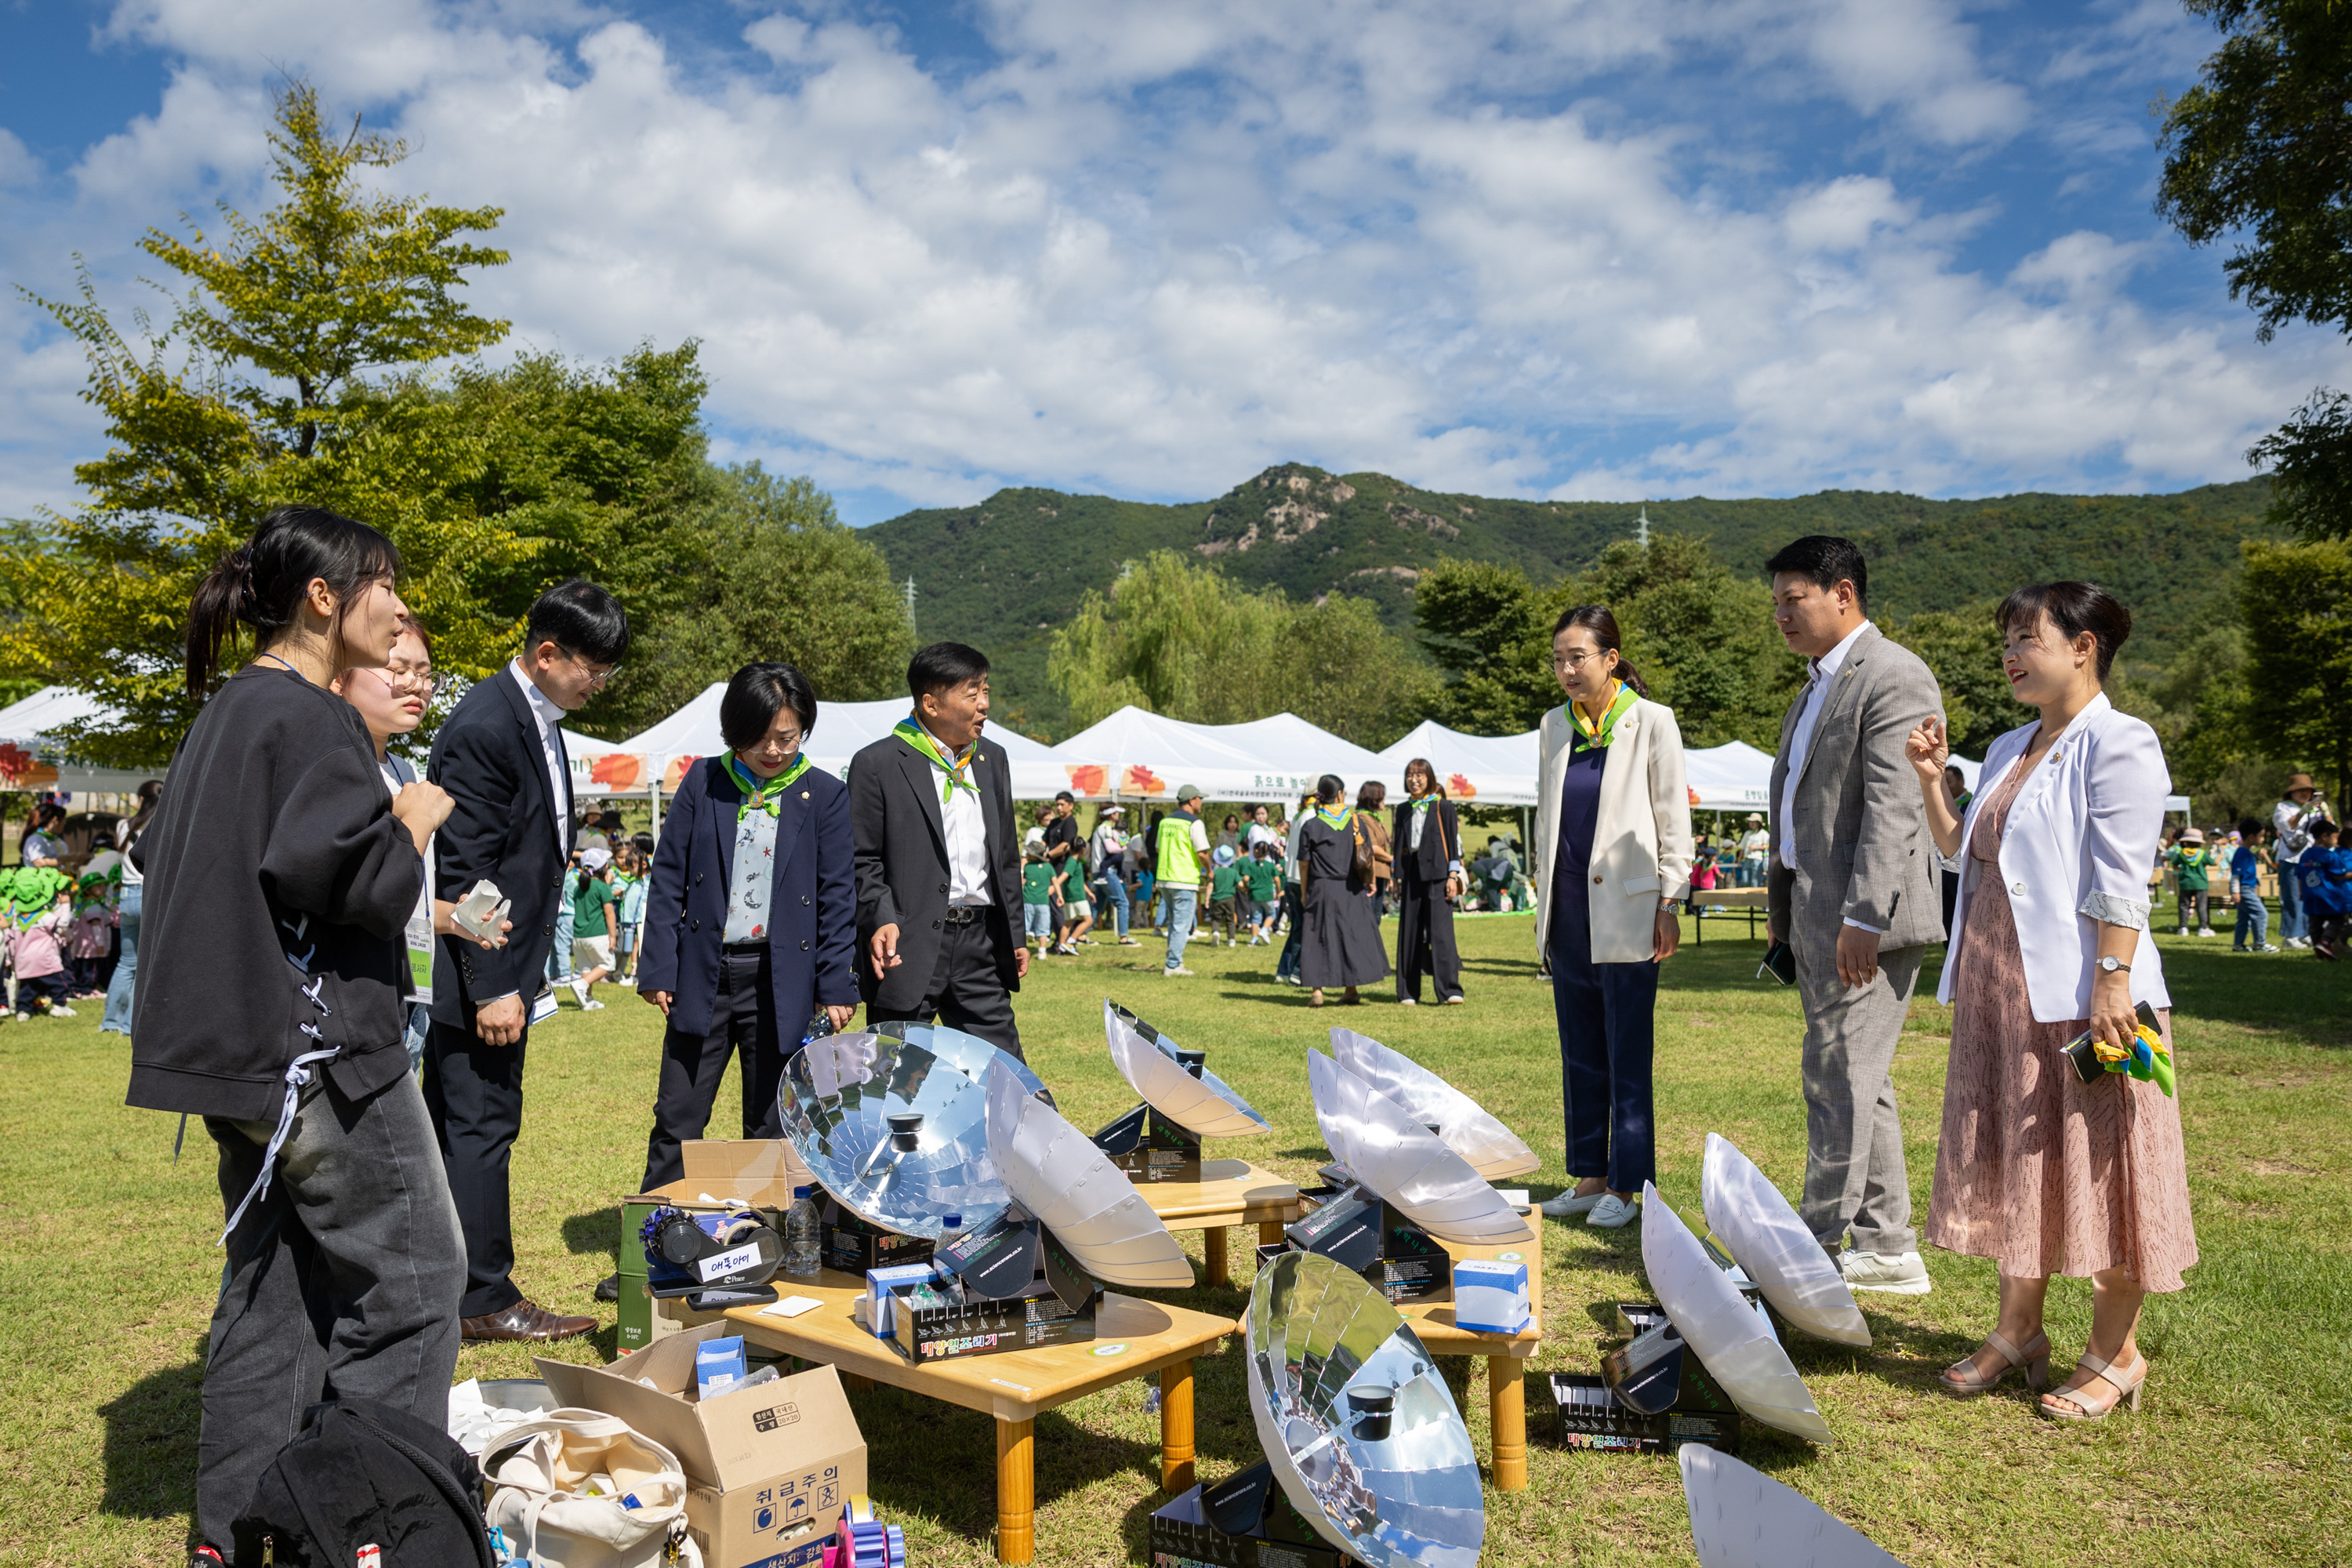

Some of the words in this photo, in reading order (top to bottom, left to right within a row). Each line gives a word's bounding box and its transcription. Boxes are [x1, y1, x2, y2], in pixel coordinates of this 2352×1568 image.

[1254, 775, 1285, 788] 흙으로
[411, 963, 427, 974] 봉사자
[979, 1246, 1022, 1278] www.sciencenara.co.kr
[920, 1334, 997, 1357] 태양열조리기
[755, 1411, 772, 1421] 원산지
[775, 1405, 793, 1415] 국내산
[1567, 1432, 1641, 1449] 태양열조리기
[1214, 1482, 1257, 1507] www.sciencenara.co.kr
